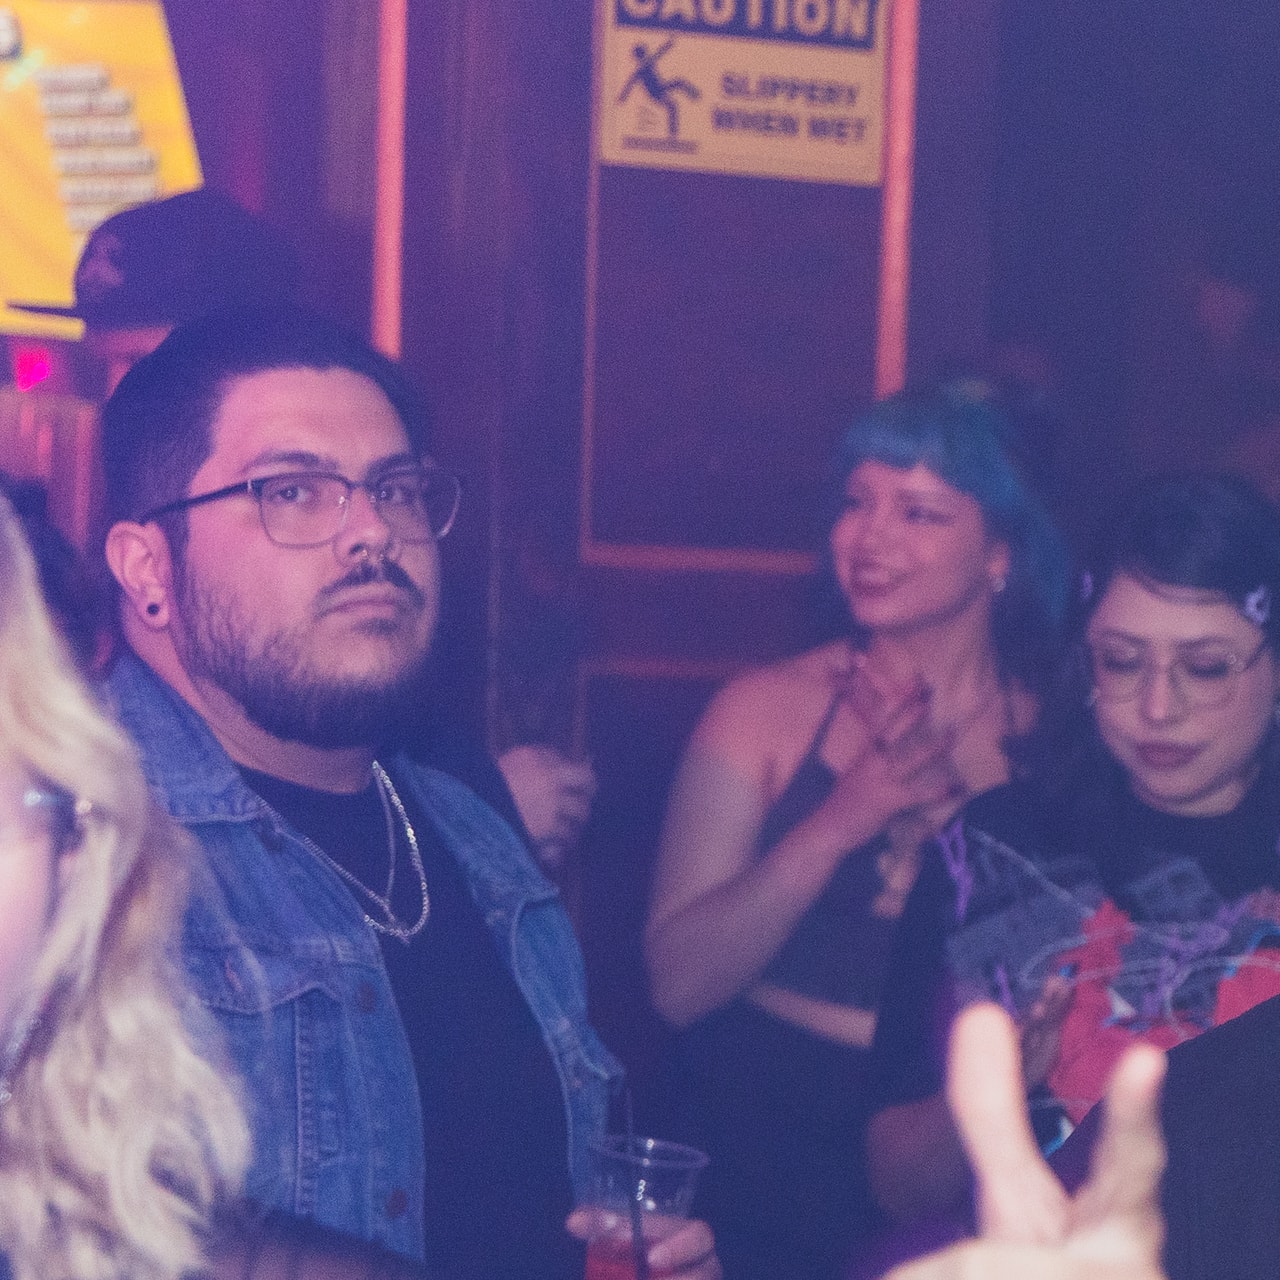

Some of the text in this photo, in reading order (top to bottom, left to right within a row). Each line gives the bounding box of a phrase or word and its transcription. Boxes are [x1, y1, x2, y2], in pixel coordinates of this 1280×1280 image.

[723, 73, 857, 105] SLIPPERY
[713, 110, 866, 142] WHEN WET
